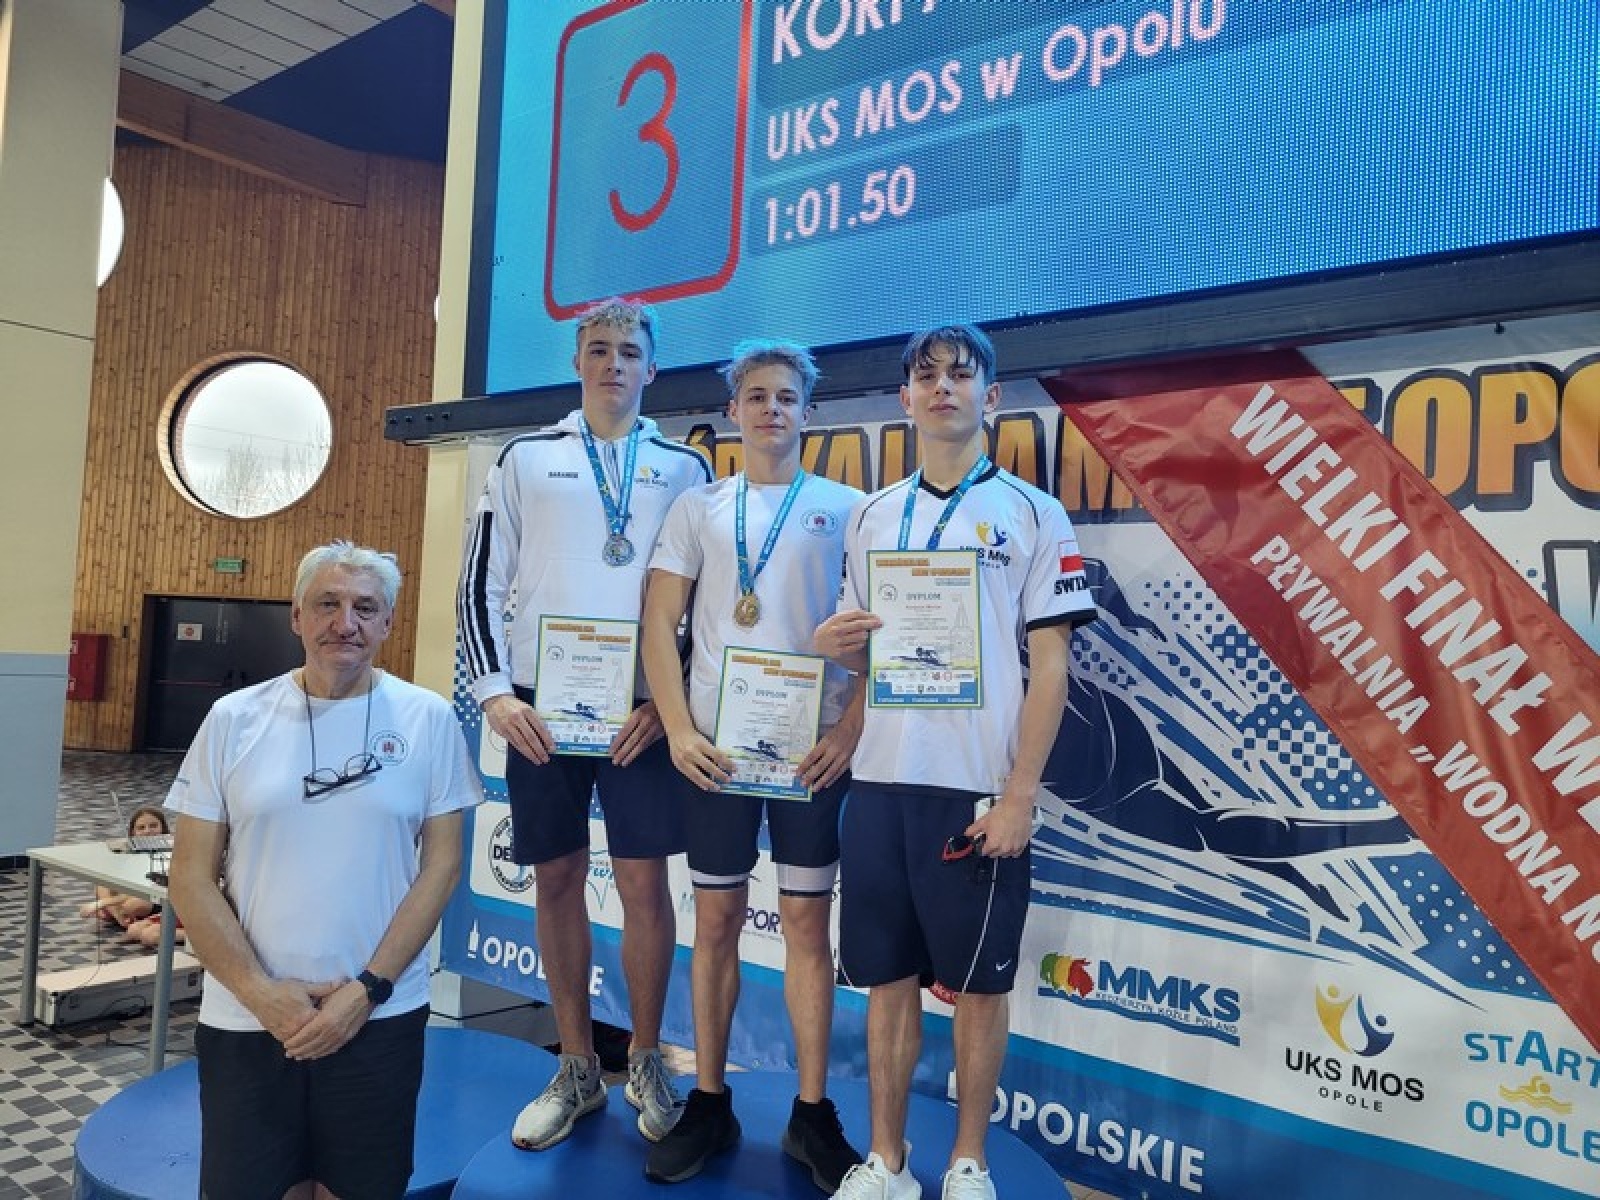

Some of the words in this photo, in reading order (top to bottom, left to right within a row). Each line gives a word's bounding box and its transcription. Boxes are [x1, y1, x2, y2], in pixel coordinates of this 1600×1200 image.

[608, 52, 681, 232] 3
[767, 97, 839, 160] UKS
[853, 61, 962, 138] MOS
[765, 165, 917, 245] 1:01.50
[1229, 383, 1411, 573] WIELKI
[1379, 550, 1553, 737] FINAŁ
[1250, 535, 1431, 735] PŁYWALNIA
[483, 936, 605, 996] OPOLE
[1098, 959, 1241, 1023] MMKS
[1285, 1047, 1342, 1082] UKS
[1351, 1064, 1425, 1102] MOS
[1318, 1086, 1383, 1113] OPOLE
[1465, 1100, 1600, 1164] OPOLE
